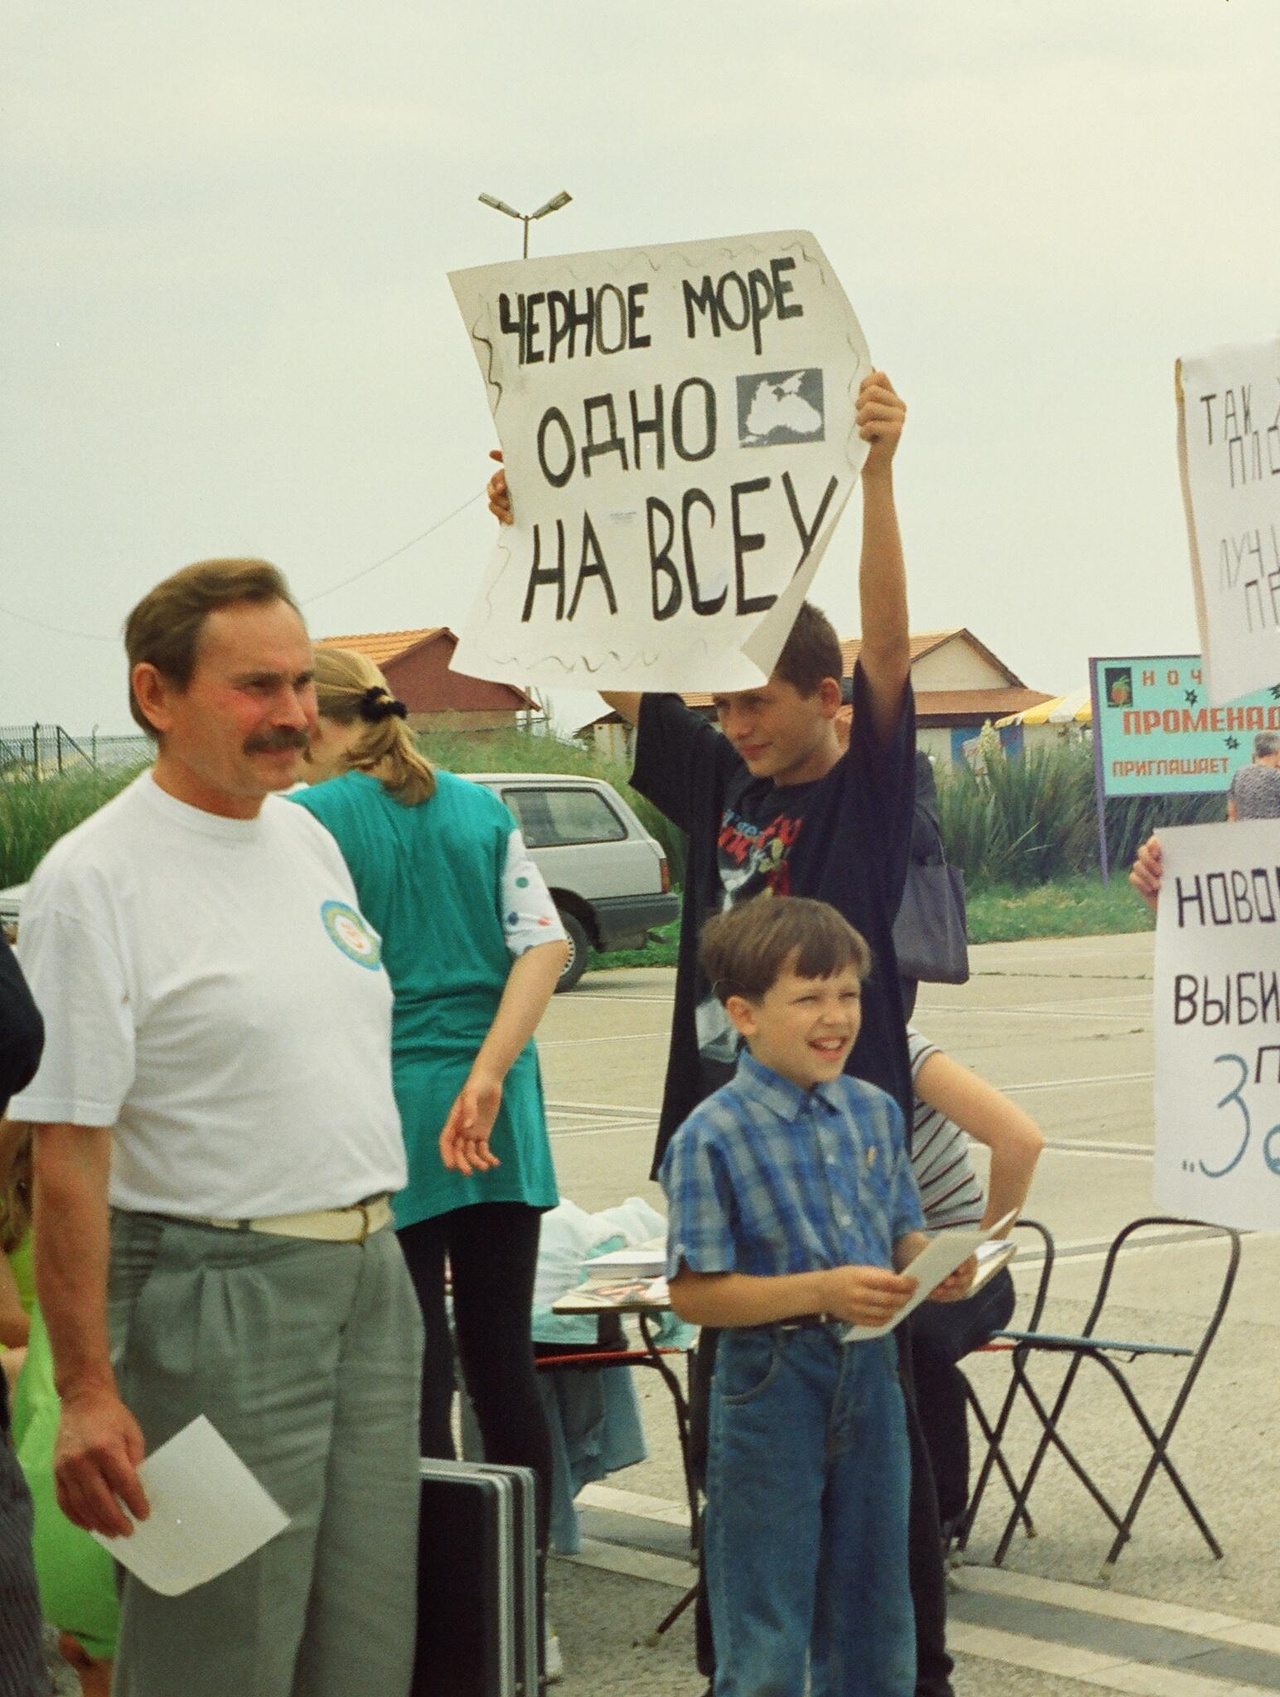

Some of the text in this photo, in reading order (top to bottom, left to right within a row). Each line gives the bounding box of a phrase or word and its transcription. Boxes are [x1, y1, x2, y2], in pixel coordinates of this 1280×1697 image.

[499, 257, 804, 365] ЧЕРНОЕ МОРЕ
[536, 377, 717, 488] ОДНО
[1200, 383, 1252, 445] ТАК
[521, 509, 618, 623] НА
[1111, 757, 1230, 778] ПРИГЛАШАЕТ
